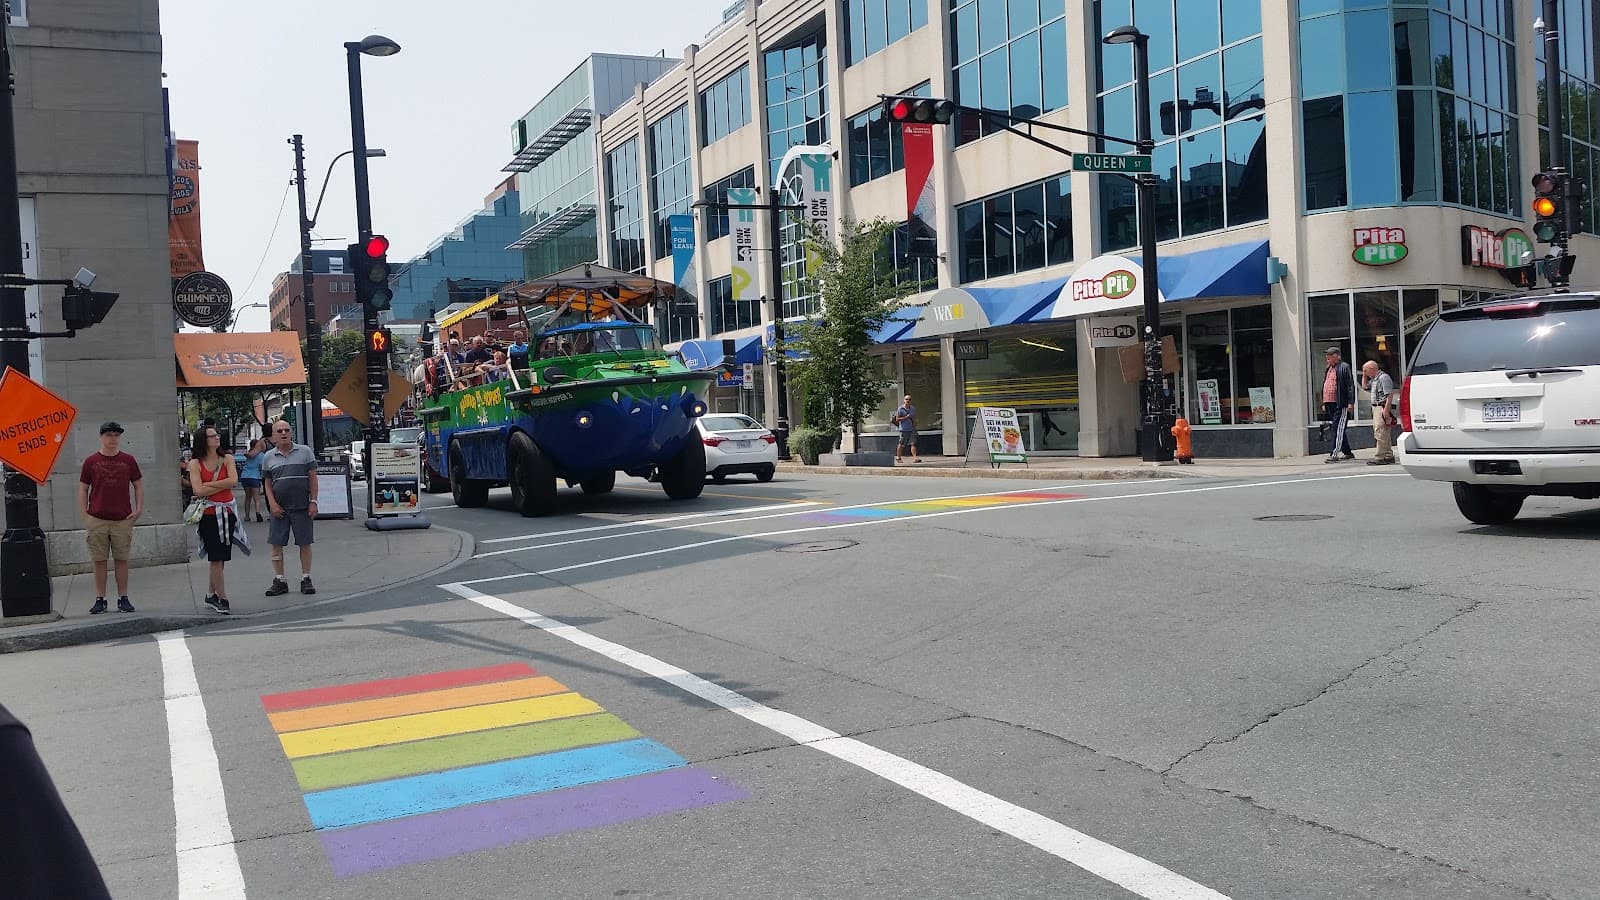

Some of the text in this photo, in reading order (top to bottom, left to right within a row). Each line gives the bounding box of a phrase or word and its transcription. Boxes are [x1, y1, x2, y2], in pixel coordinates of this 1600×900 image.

[1083, 156, 1126, 169] QUEEN
[819, 198, 827, 217] NFB
[743, 228, 751, 244] NFB
[1354, 228, 1404, 246] Pita
[1364, 245, 1397, 261] Pit
[1471, 228, 1505, 266] Pita
[1073, 275, 1130, 300] Pita Pit
[177, 293, 229, 303] CHIMNEYS
[1093, 327, 1132, 337] Pita Pit
[0, 409, 68, 440] NSTRUCTION
[18, 435, 47, 454] ENDS
